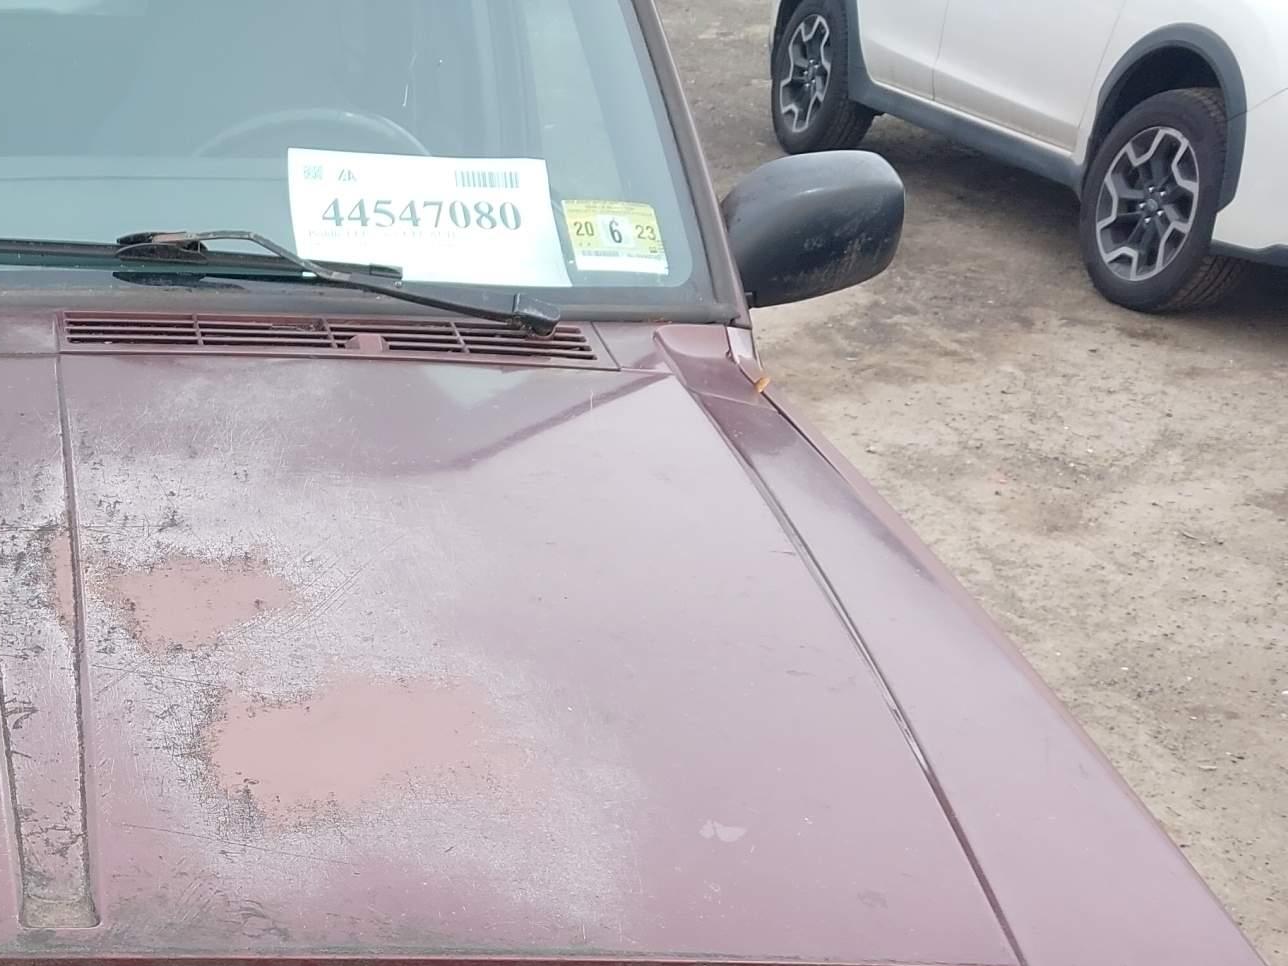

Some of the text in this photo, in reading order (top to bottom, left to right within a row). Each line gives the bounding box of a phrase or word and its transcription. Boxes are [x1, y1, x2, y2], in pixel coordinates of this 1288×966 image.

[321, 197, 523, 231] 44547080
[573, 218, 657, 244] 20 6 23
